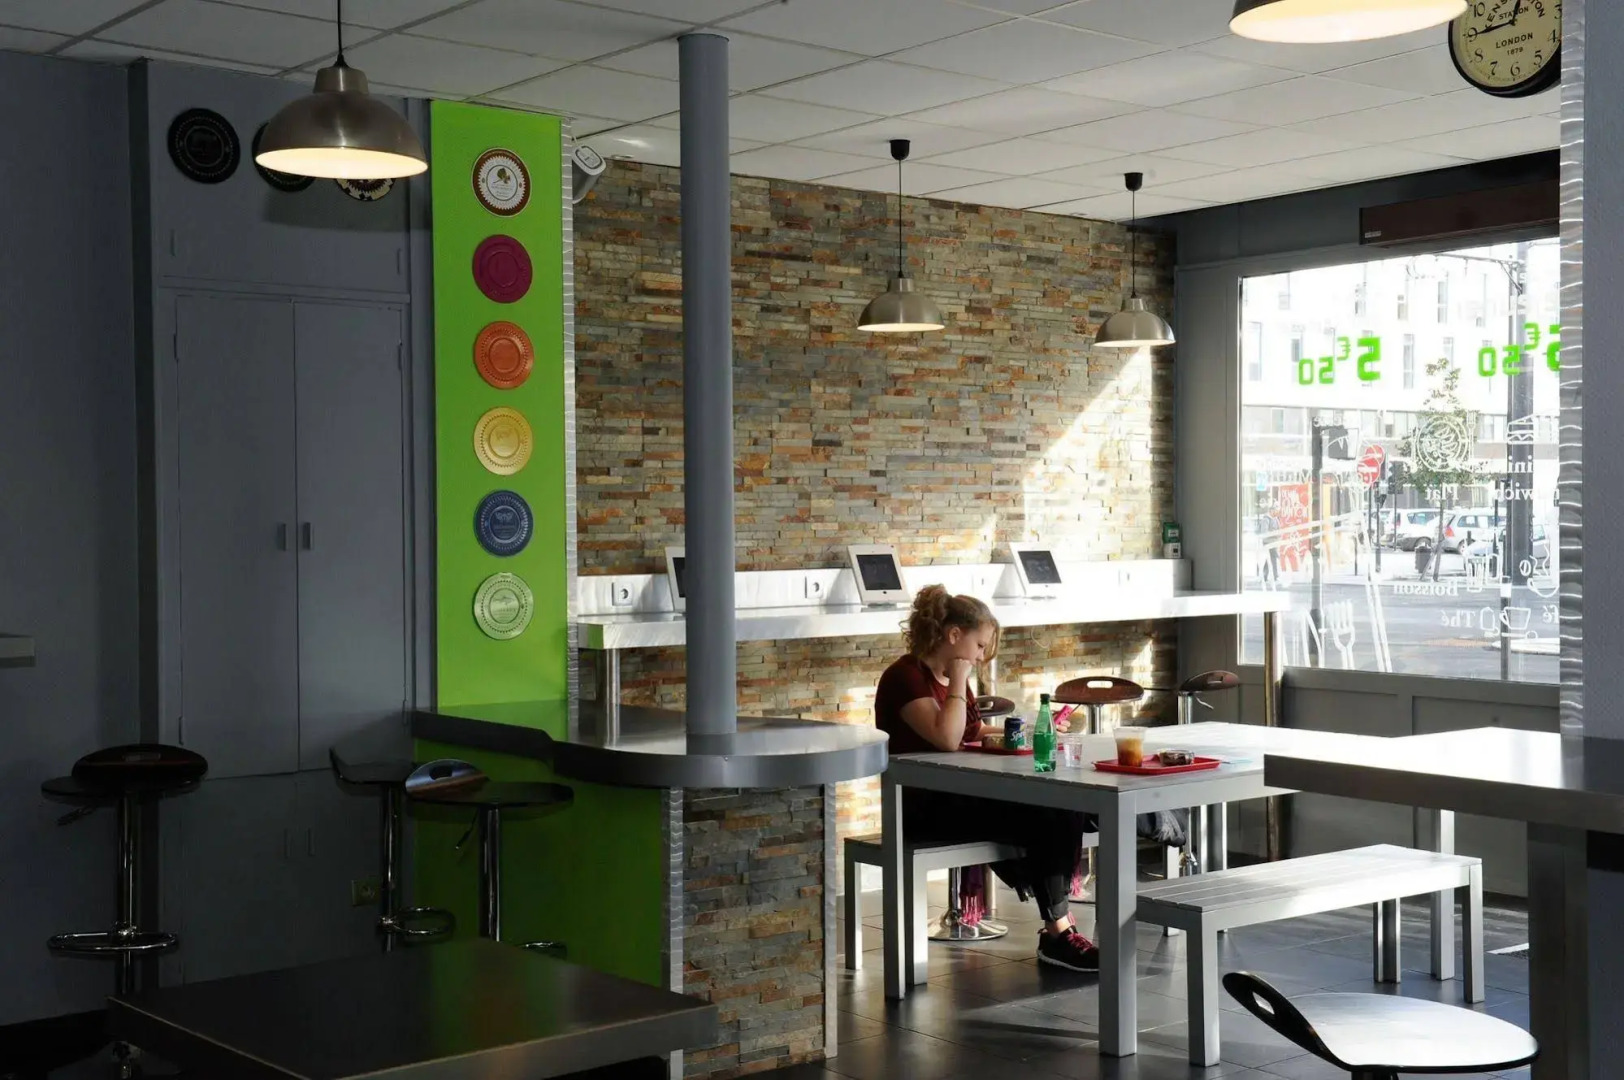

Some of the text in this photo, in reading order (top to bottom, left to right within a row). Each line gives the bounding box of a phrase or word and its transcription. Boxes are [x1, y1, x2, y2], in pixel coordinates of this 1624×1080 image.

[1473, 2, 1485, 17] 10
[1498, 6, 1529, 20] STAON
[1467, 27, 1478, 42] 9
[1496, 32, 1533, 49] LONDON
[1547, 29, 1560, 43] 4
[1474, 47, 1484, 62] 8
[1533, 50, 1543, 67] 5
[1490, 61, 1498, 76] 7
[1510, 61, 1521, 76] 6
